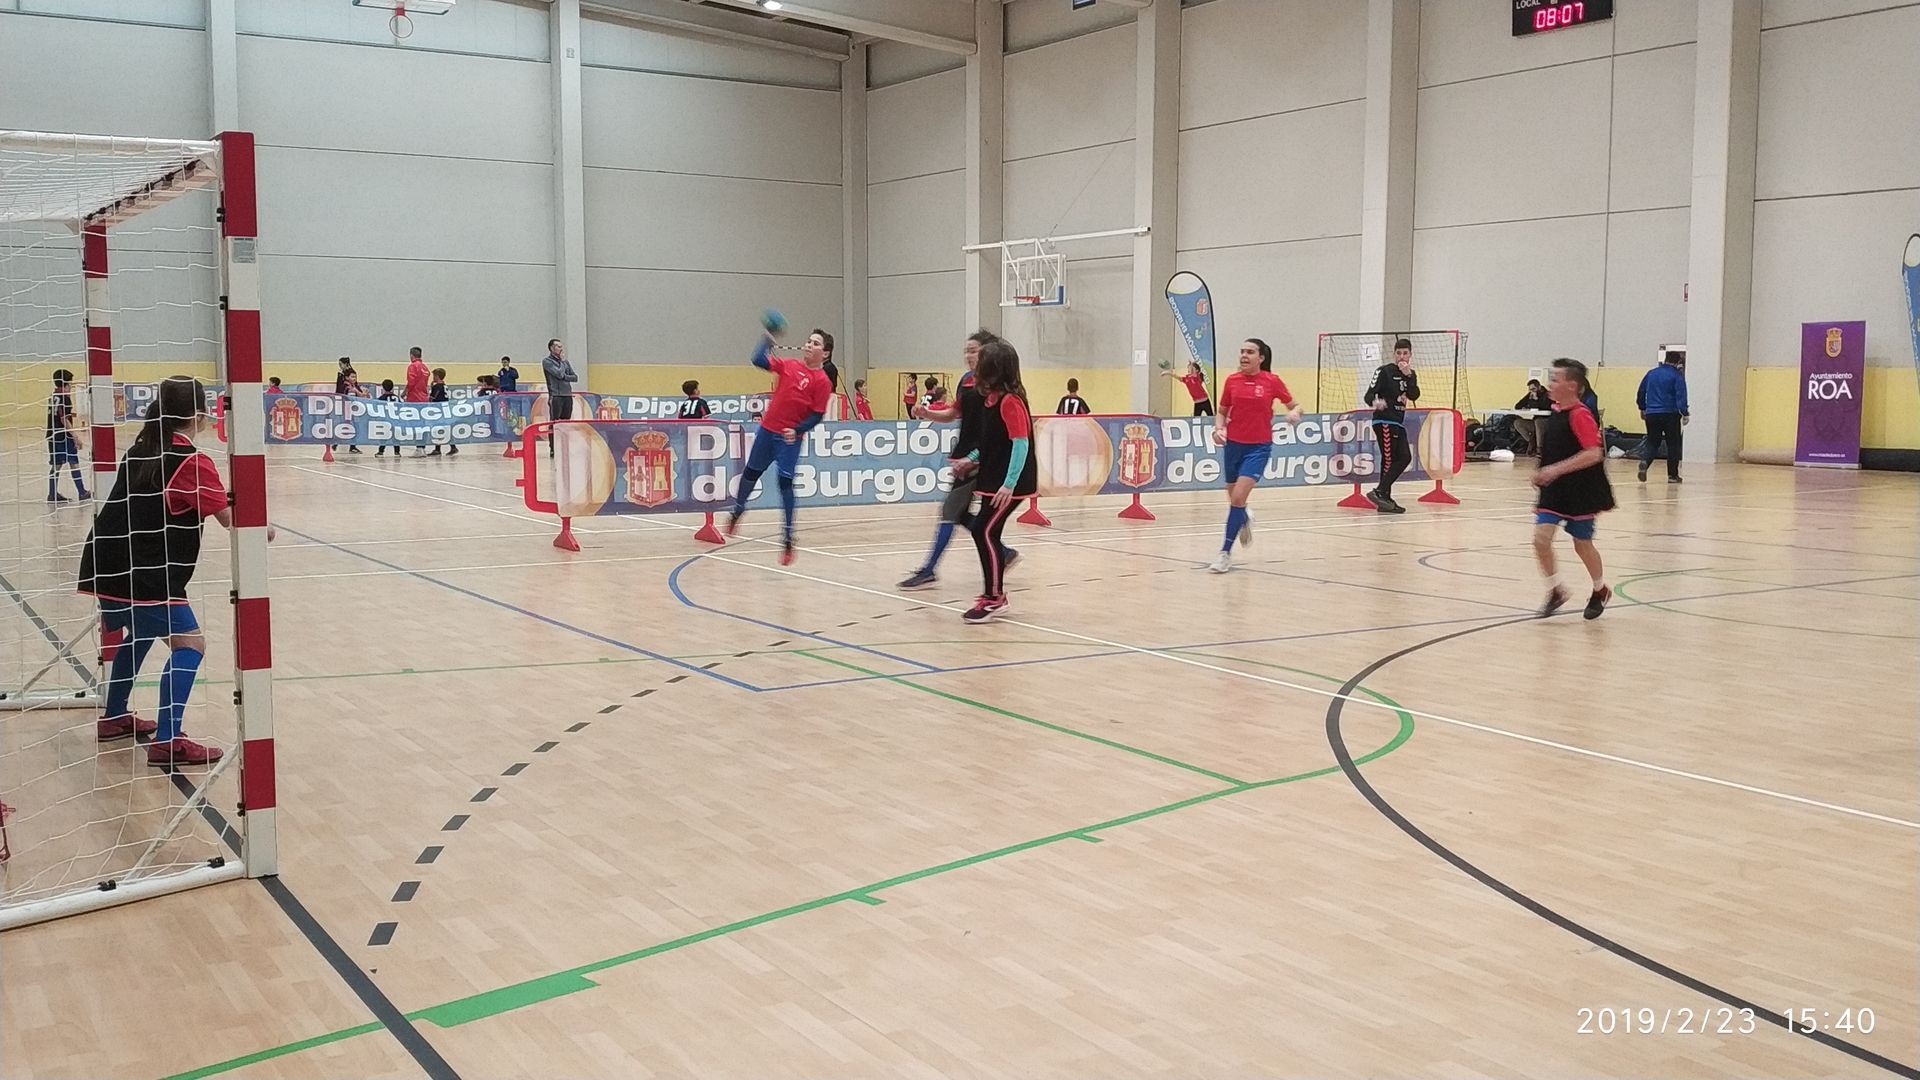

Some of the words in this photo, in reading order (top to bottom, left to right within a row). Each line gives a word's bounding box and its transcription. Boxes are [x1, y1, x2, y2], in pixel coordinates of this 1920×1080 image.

[1536, 3, 1584, 28] 08:07
[1808, 380, 1853, 400] ROA
[308, 395, 493, 421] Diputación
[627, 396, 772, 419] Dipació
[1064, 398, 1080, 416] 17
[311, 419, 357, 440] de
[367, 420, 493, 444] Burgos
[687, 421, 960, 461] Ditación
[1160, 414, 1378, 454] Dipación
[1166, 452, 1221, 484] de
[1262, 451, 1375, 485] urgos
